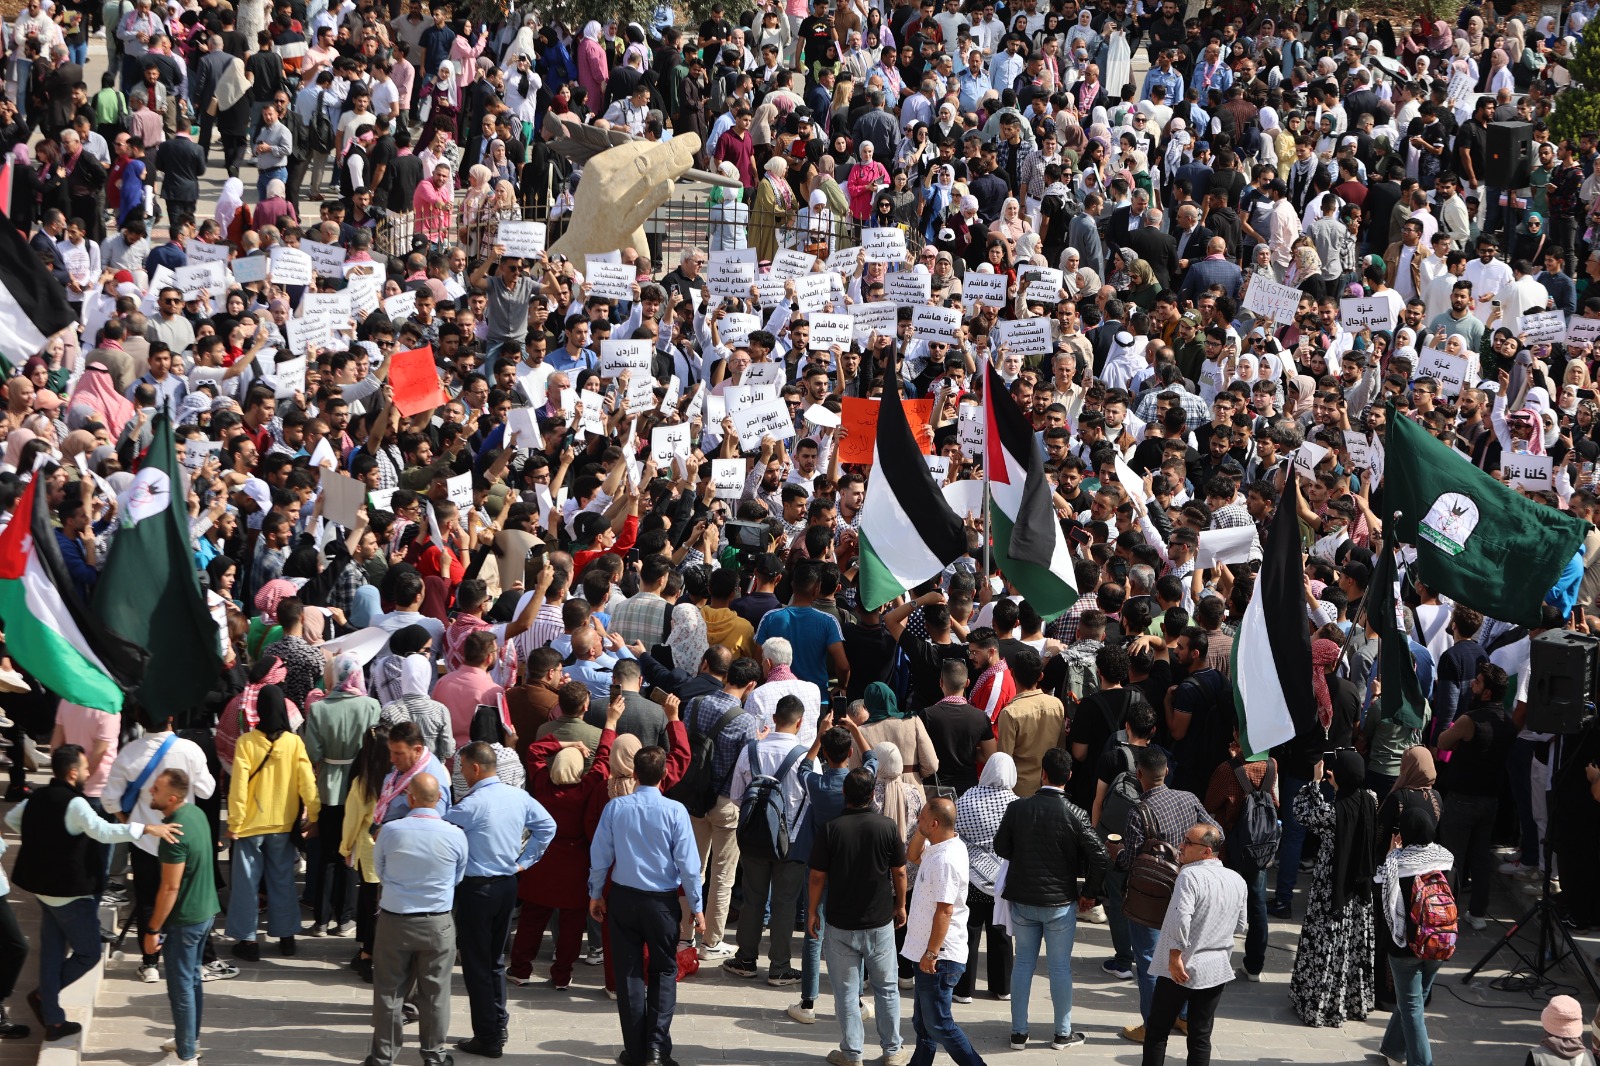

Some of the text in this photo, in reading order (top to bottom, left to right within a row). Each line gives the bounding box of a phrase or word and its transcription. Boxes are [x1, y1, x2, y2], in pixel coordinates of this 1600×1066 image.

[593, 272, 629, 282] المستشفيات
[708, 276, 753, 285] القطاع الصحي
[593, 281, 629, 290] والمدنيين
[890, 282, 926, 291] المستشفيات
[967, 277, 988, 289] هاشم
[1251, 275, 1302, 302] PALESTINIAN
[609, 289, 627, 298] جريمة
[889, 289, 925, 298] والمدنيين
[984, 292, 1004, 302] قلعة
[1037, 292, 1055, 300] جريمة
[1253, 293, 1290, 308] LIVES
[917, 311, 942, 322] هاشم
[1251, 301, 1295, 321] MATTER
[814, 319, 838, 330] هاشم
[1013, 320, 1037, 329] قصف
[1345, 315, 1389, 327] منبع الرجال
[914, 325, 956, 337] لعة صمود
[1006, 327, 1045, 339] المستشفيات
[1572, 323, 1595, 332] هاشم
[811, 335, 851, 346] قلعة صمود
[1008, 336, 1046, 347] والمدنيين
[1009, 344, 1047, 355] جريمة حرب
[604, 359, 638, 371] فلسطين
[1418, 366, 1460, 385] منبع الرجال
[738, 391, 765, 404] الأردن
[761, 409, 780, 423] اللهم
[740, 428, 754, 440] غزة
[754, 426, 767, 437] في
[962, 436, 983, 447] لصحي
